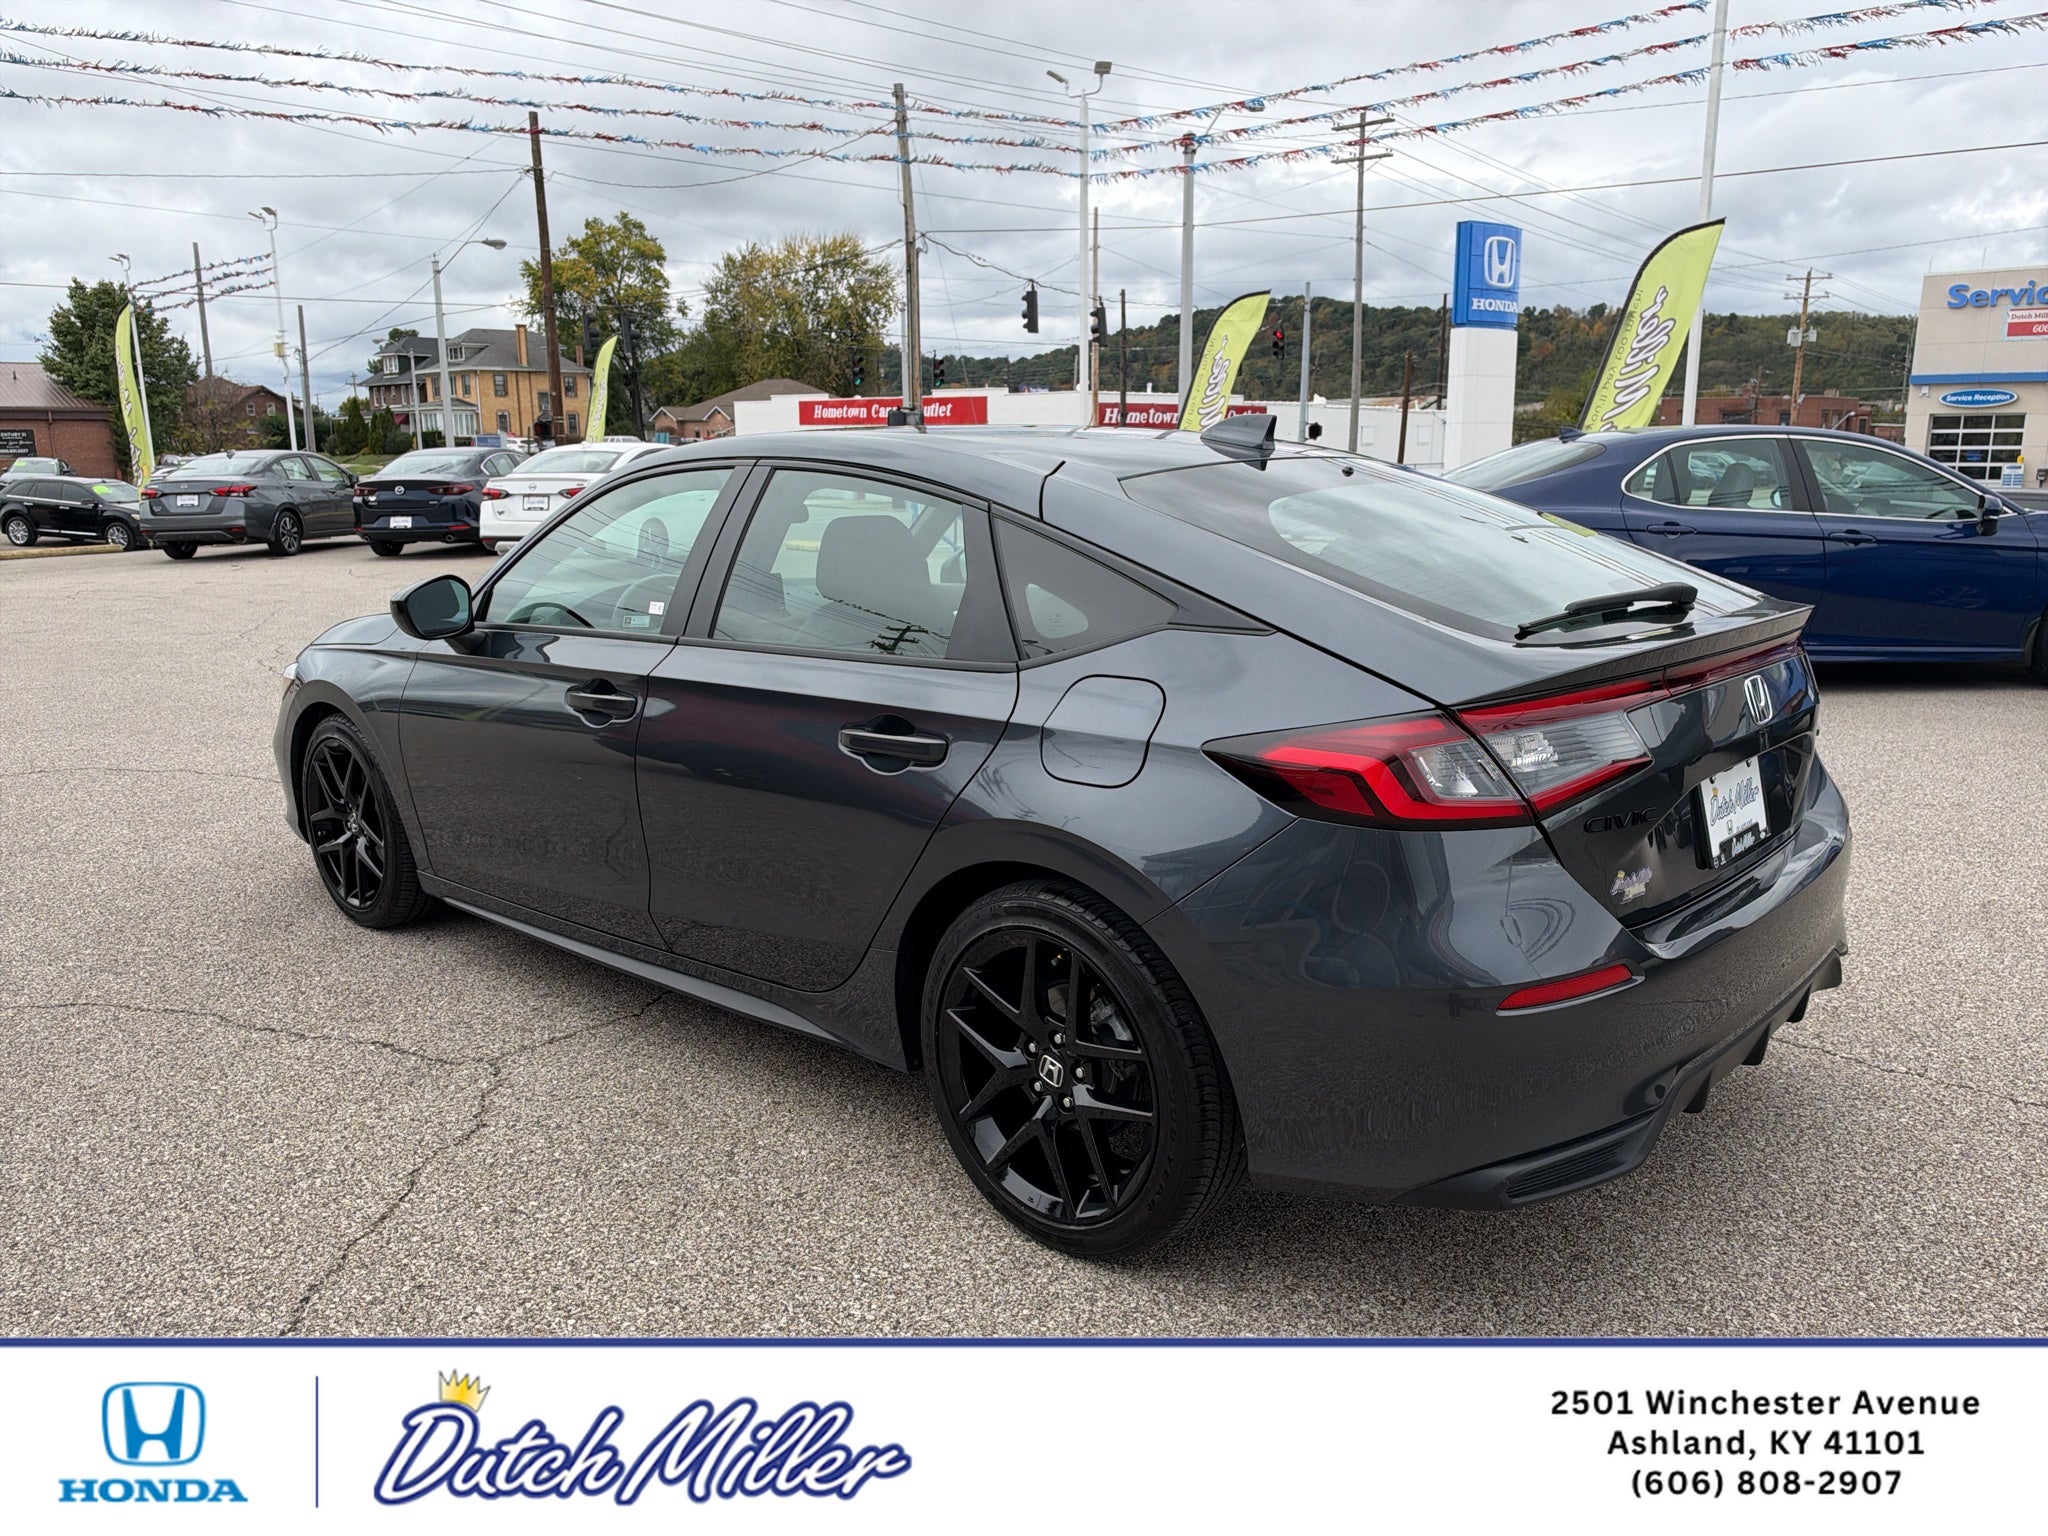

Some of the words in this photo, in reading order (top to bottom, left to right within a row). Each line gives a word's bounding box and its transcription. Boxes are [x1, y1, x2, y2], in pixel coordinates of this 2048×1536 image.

[1471, 298, 1518, 313] HONDA
[1946, 394, 1973, 402] Service
[1974, 393, 2010, 402] Reception
[814, 404, 867, 418] Hometown
[923, 403, 952, 417] utlet
[1583, 806, 1657, 834] CIVIC
